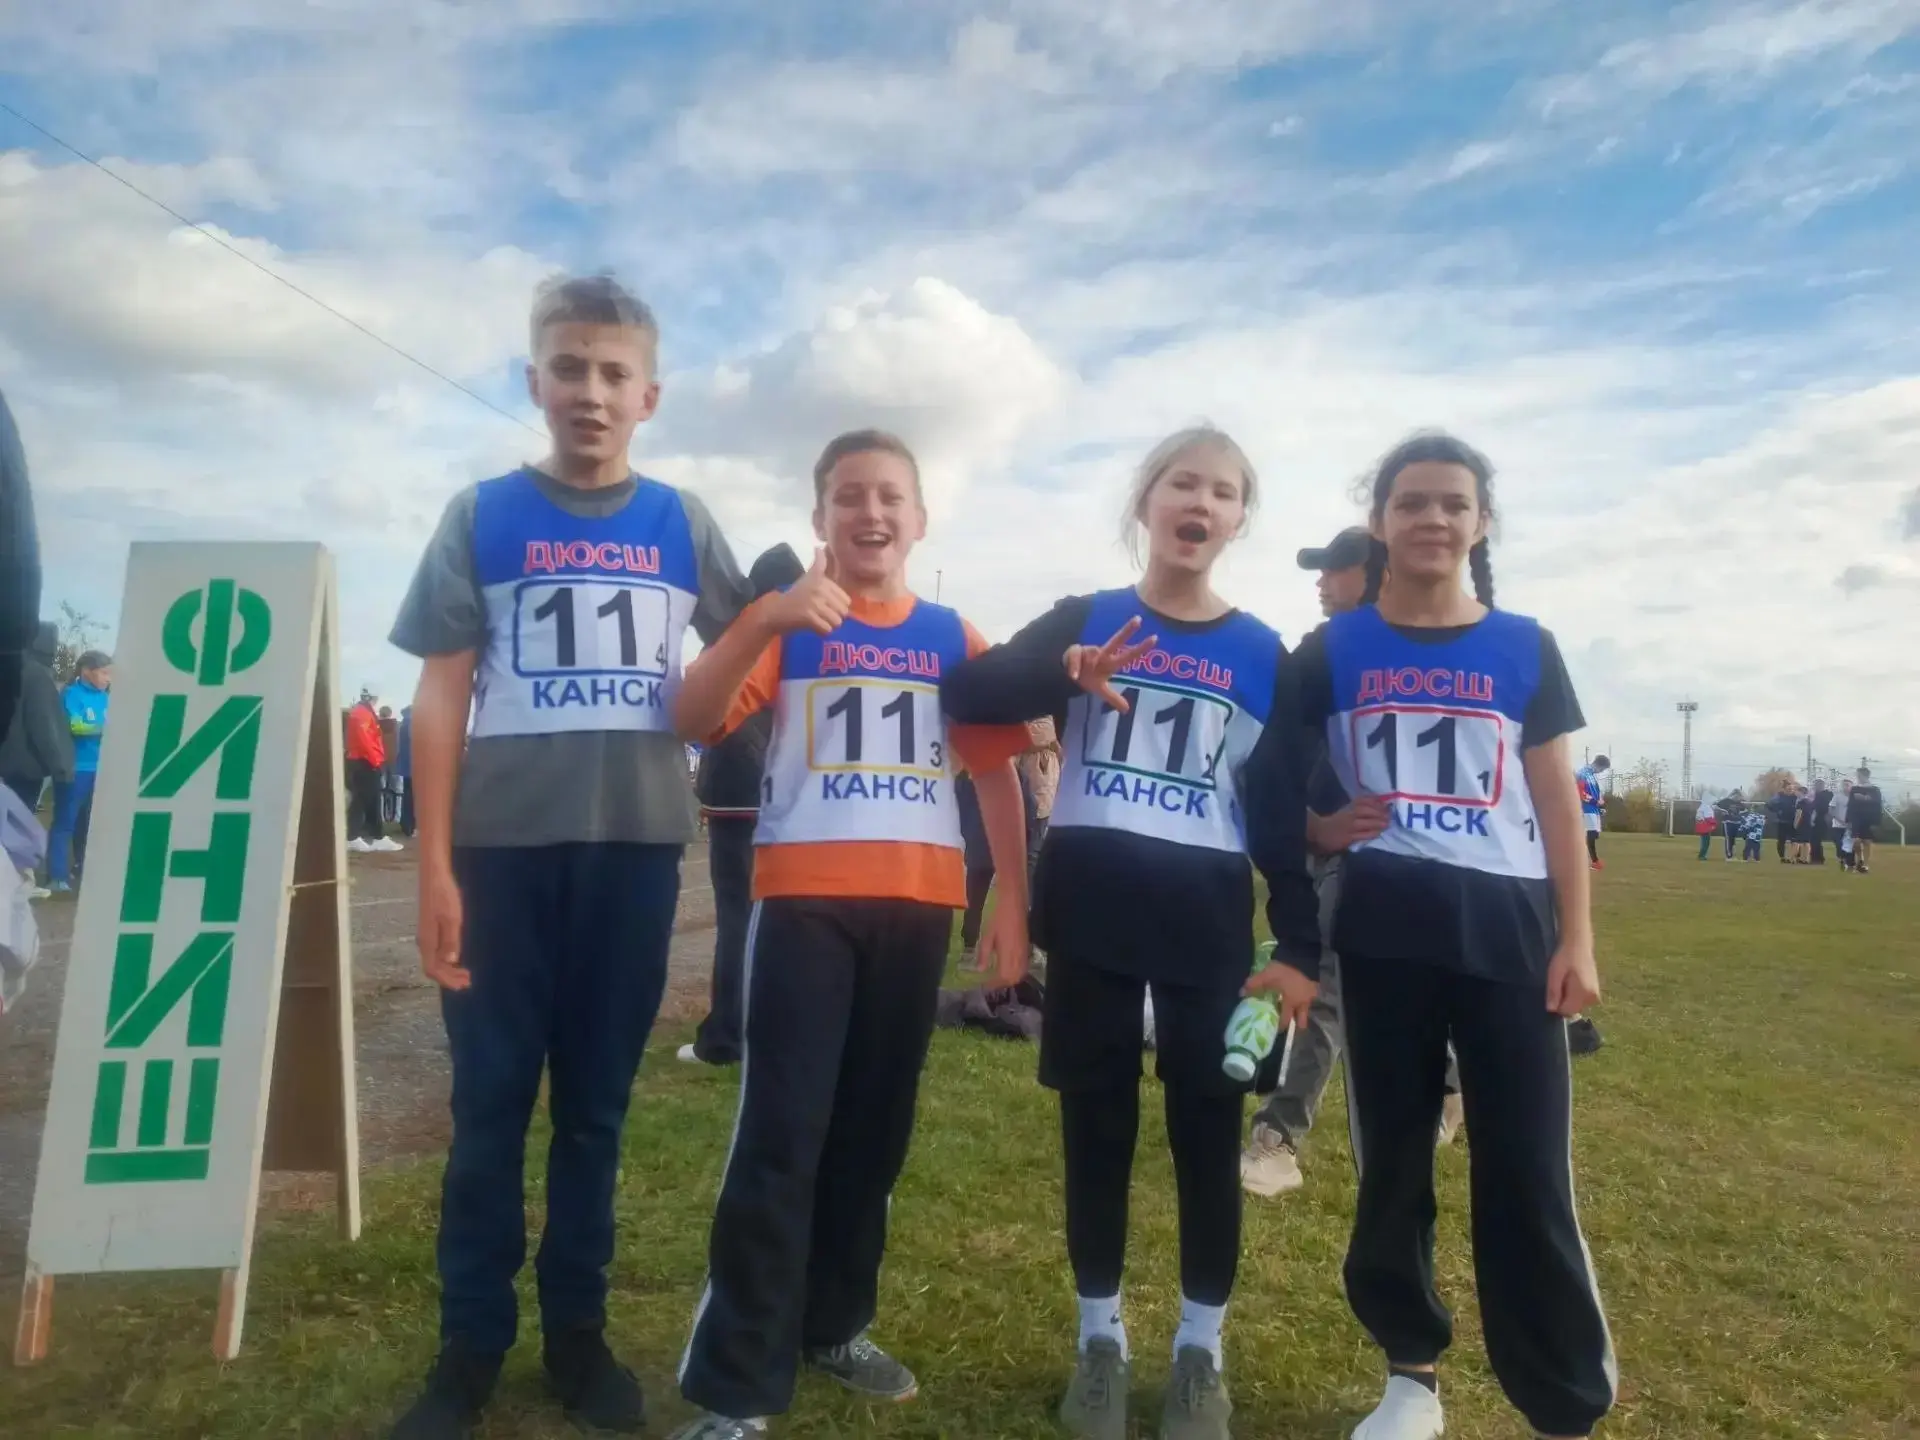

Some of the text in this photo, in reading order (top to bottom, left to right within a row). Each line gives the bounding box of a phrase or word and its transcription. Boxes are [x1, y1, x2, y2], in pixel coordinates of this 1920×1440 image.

[524, 541, 660, 574] ДЮСШ
[534, 586, 668, 669] 11 4
[819, 640, 940, 678] ДЮСШ
[533, 678, 663, 709] КАНСК
[1357, 667, 1493, 704] ДЮСШ
[826, 686, 942, 768] 11 3
[1100, 686, 1215, 780] 11 2
[1366, 712, 1490, 795] 11 1
[822, 772, 938, 805] КАНСК
[1085, 768, 1209, 818] КАНСК
[1523, 817, 1535, 843] 1
[84, 578, 272, 1185] ФИНИШ
